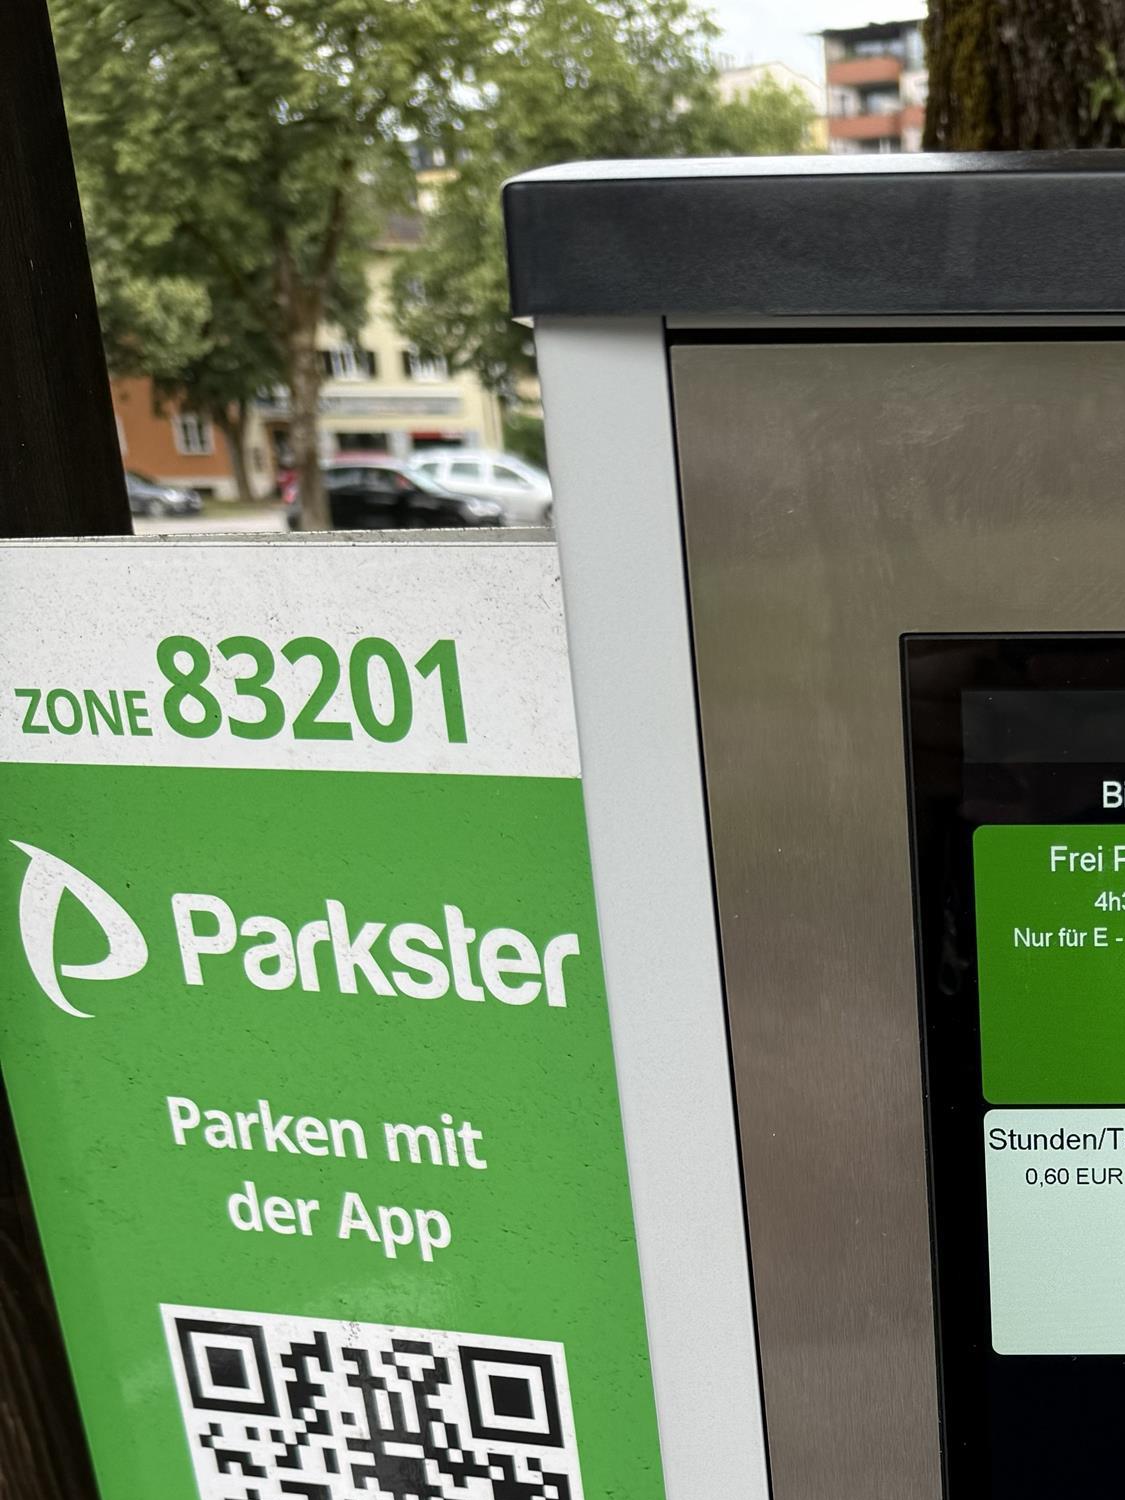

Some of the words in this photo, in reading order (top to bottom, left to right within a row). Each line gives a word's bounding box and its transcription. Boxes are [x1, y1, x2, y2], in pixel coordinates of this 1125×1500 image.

[15, 688, 153, 737] ZONE
[156, 635, 468, 744] 83201
[1050, 846, 1104, 872] Frei
[172, 893, 580, 1008] Parkster
[1013, 928, 1052, 948] Nur
[1057, 927, 1088, 947] für
[166, 1096, 367, 1160] Parken
[384, 1113, 487, 1170] mit
[1025, 1167, 1070, 1189] 0,60
[1077, 1167, 1124, 1185] EUR
[228, 1180, 319, 1236] der
[337, 1192, 452, 1262] App
